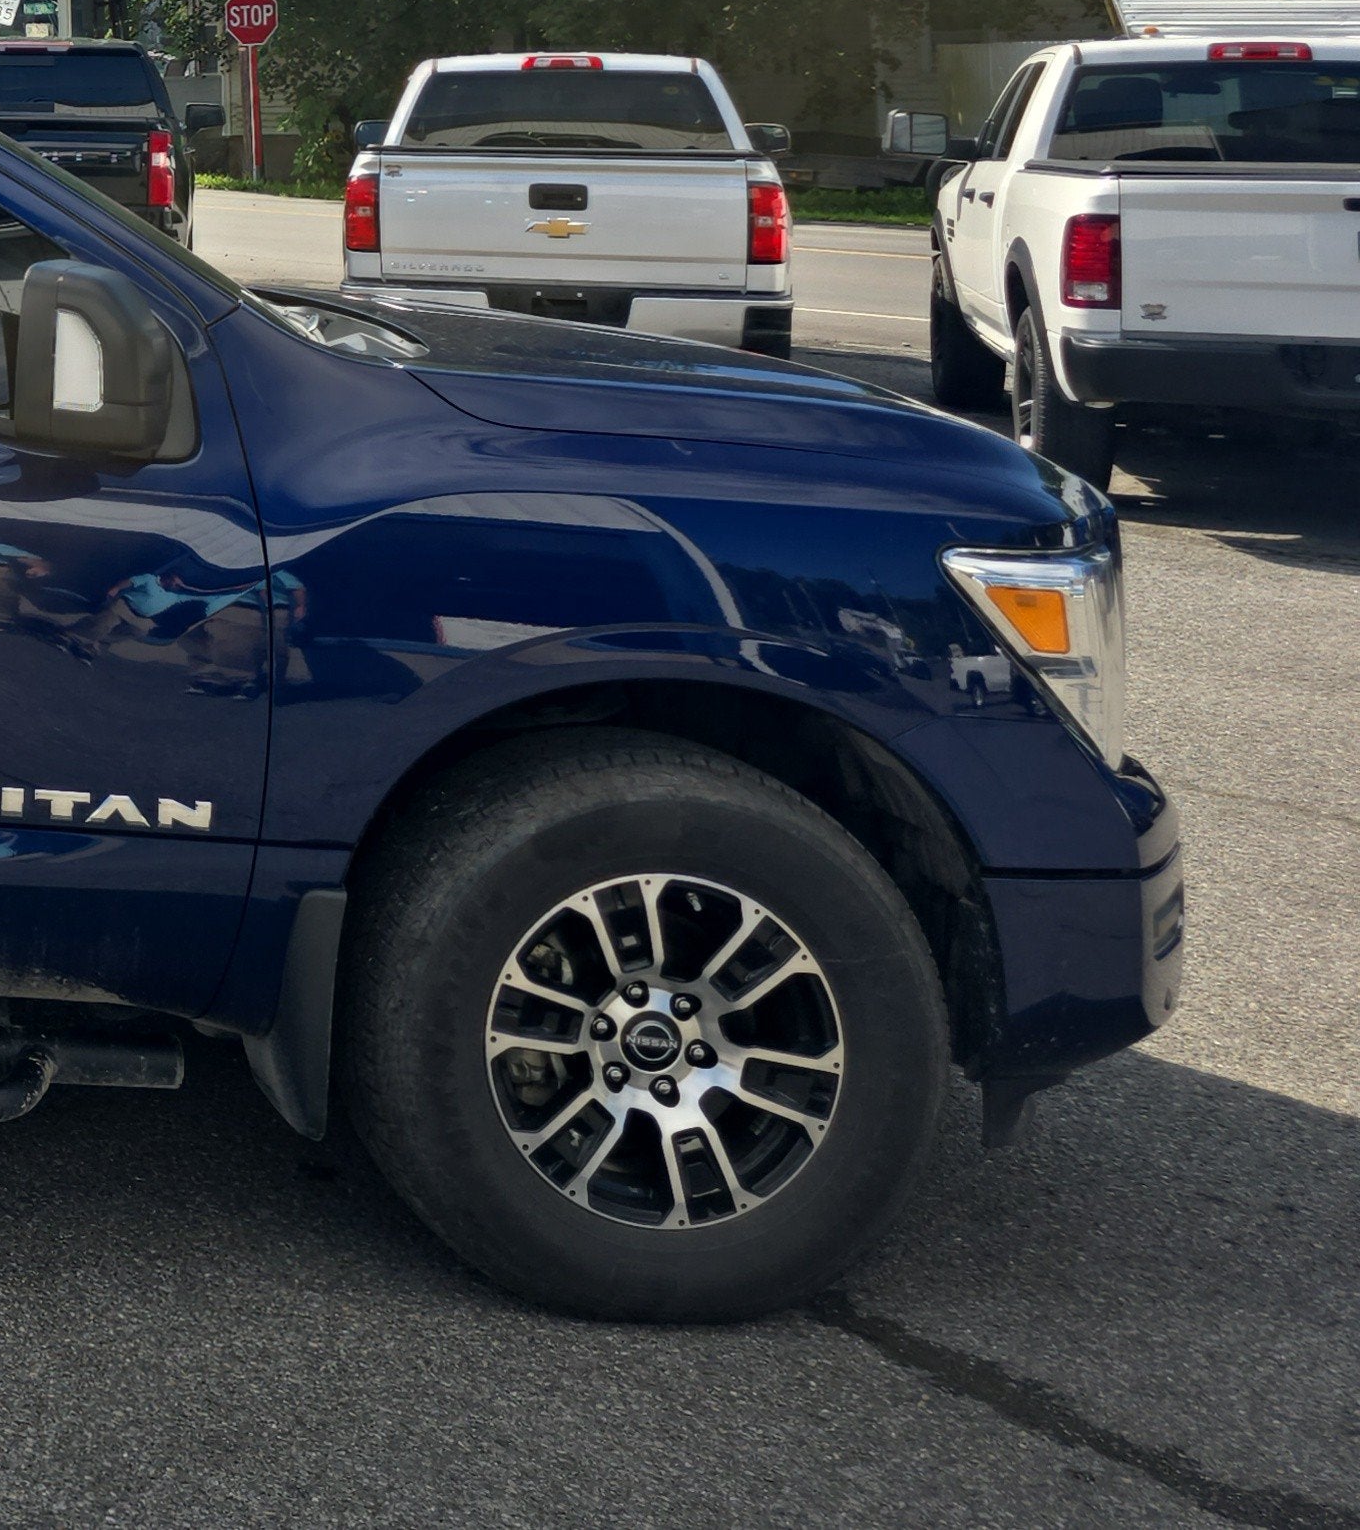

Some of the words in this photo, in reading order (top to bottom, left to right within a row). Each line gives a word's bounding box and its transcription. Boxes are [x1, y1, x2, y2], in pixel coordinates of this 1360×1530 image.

[230, 4, 273, 27] STOP
[390, 261, 485, 273] SILVERADO
[626, 1034, 678, 1049] NISSAN
